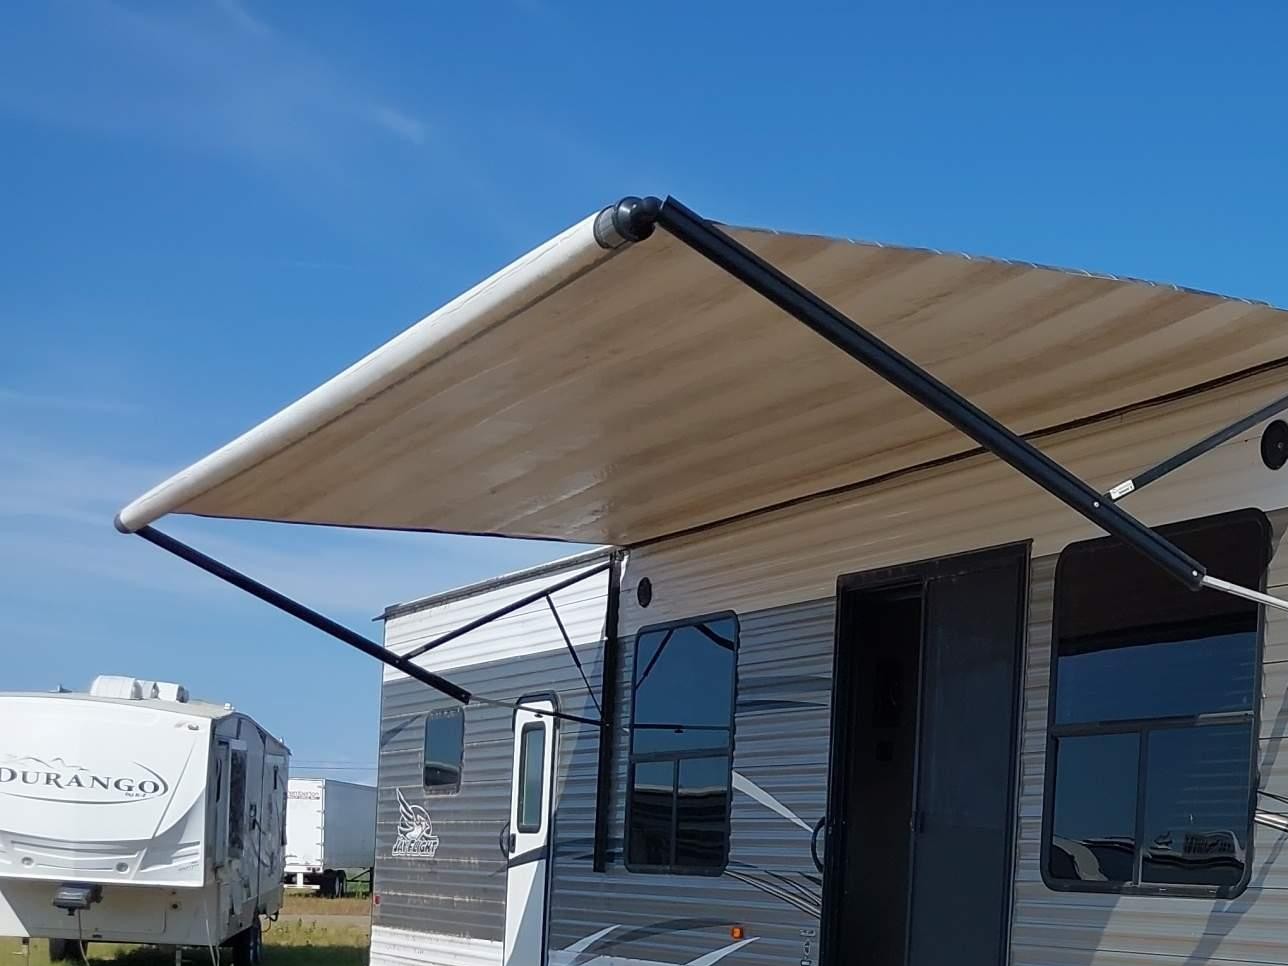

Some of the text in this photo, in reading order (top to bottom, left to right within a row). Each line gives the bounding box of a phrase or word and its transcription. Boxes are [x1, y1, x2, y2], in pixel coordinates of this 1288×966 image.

[0, 767, 160, 793] DURANGO
[392, 837, 439, 857] JAY FLIGHT
